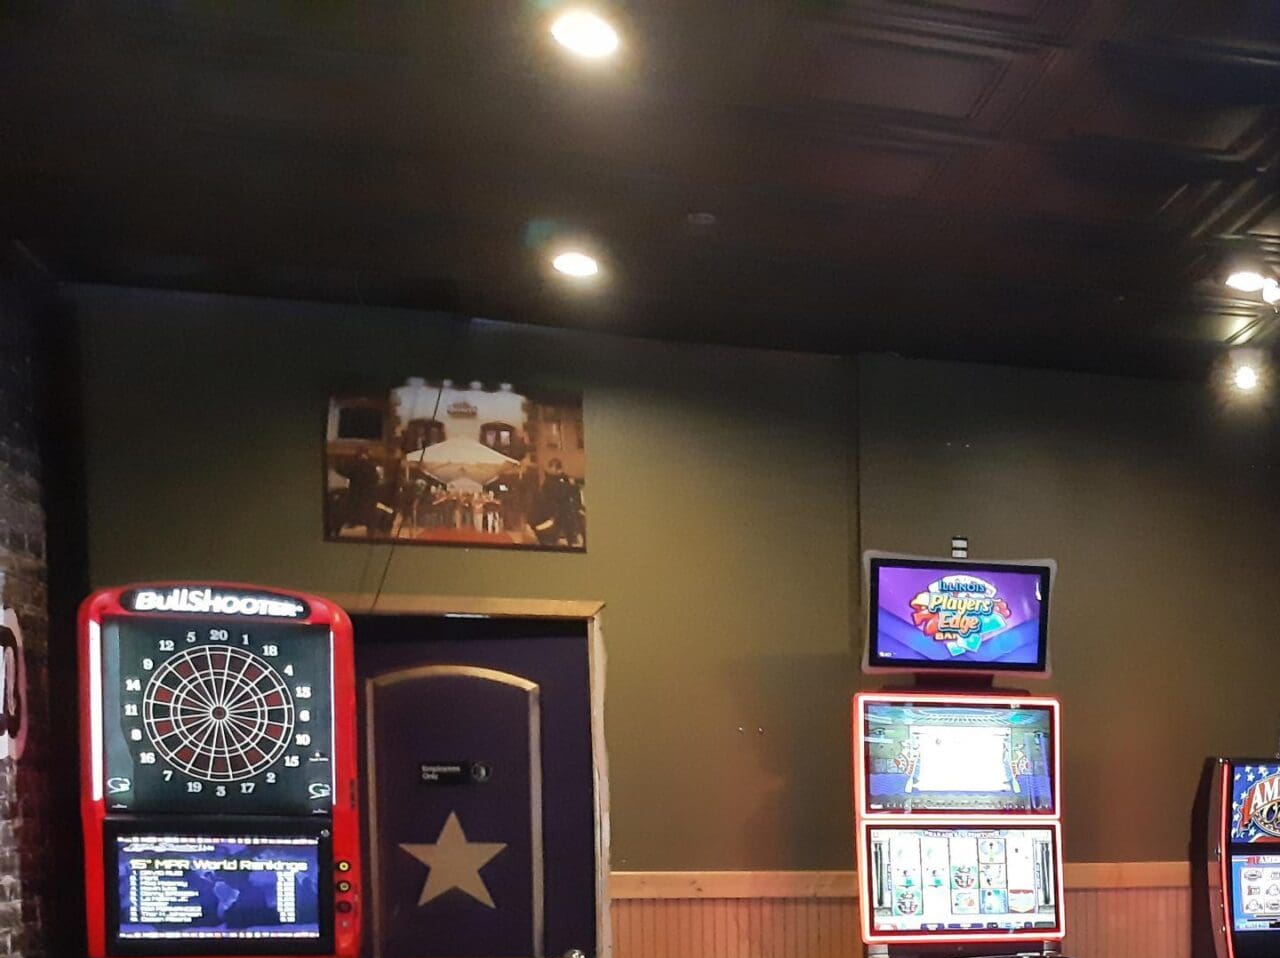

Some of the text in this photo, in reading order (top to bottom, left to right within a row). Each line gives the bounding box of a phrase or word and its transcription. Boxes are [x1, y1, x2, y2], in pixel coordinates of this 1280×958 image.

[938, 579, 986, 592] ILLINOIS
[939, 611, 980, 634] Edge
[186, 632, 196, 643] 5
[209, 630, 228, 641] 20
[159, 640, 175, 651] 12
[262, 645, 278, 656] 18
[143, 659, 154, 670] 9
[284, 665, 293, 676] 4
[126, 679, 141, 691] 14
[125, 704, 138, 716] 11
[300, 710, 310, 722] 6
[295, 734, 311, 746] 10
[140, 752, 155, 764] 16
[285, 756, 299, 768] 15
[163, 770, 173, 781] 7
[266, 772, 276, 783] 2
[187, 782, 202, 793] 19
[216, 786, 226, 797] 3
[240, 782, 255, 794] 17
[155, 859, 190, 870] MPR
[193, 859, 237, 870] World
[240, 860, 308, 874] Rankings
